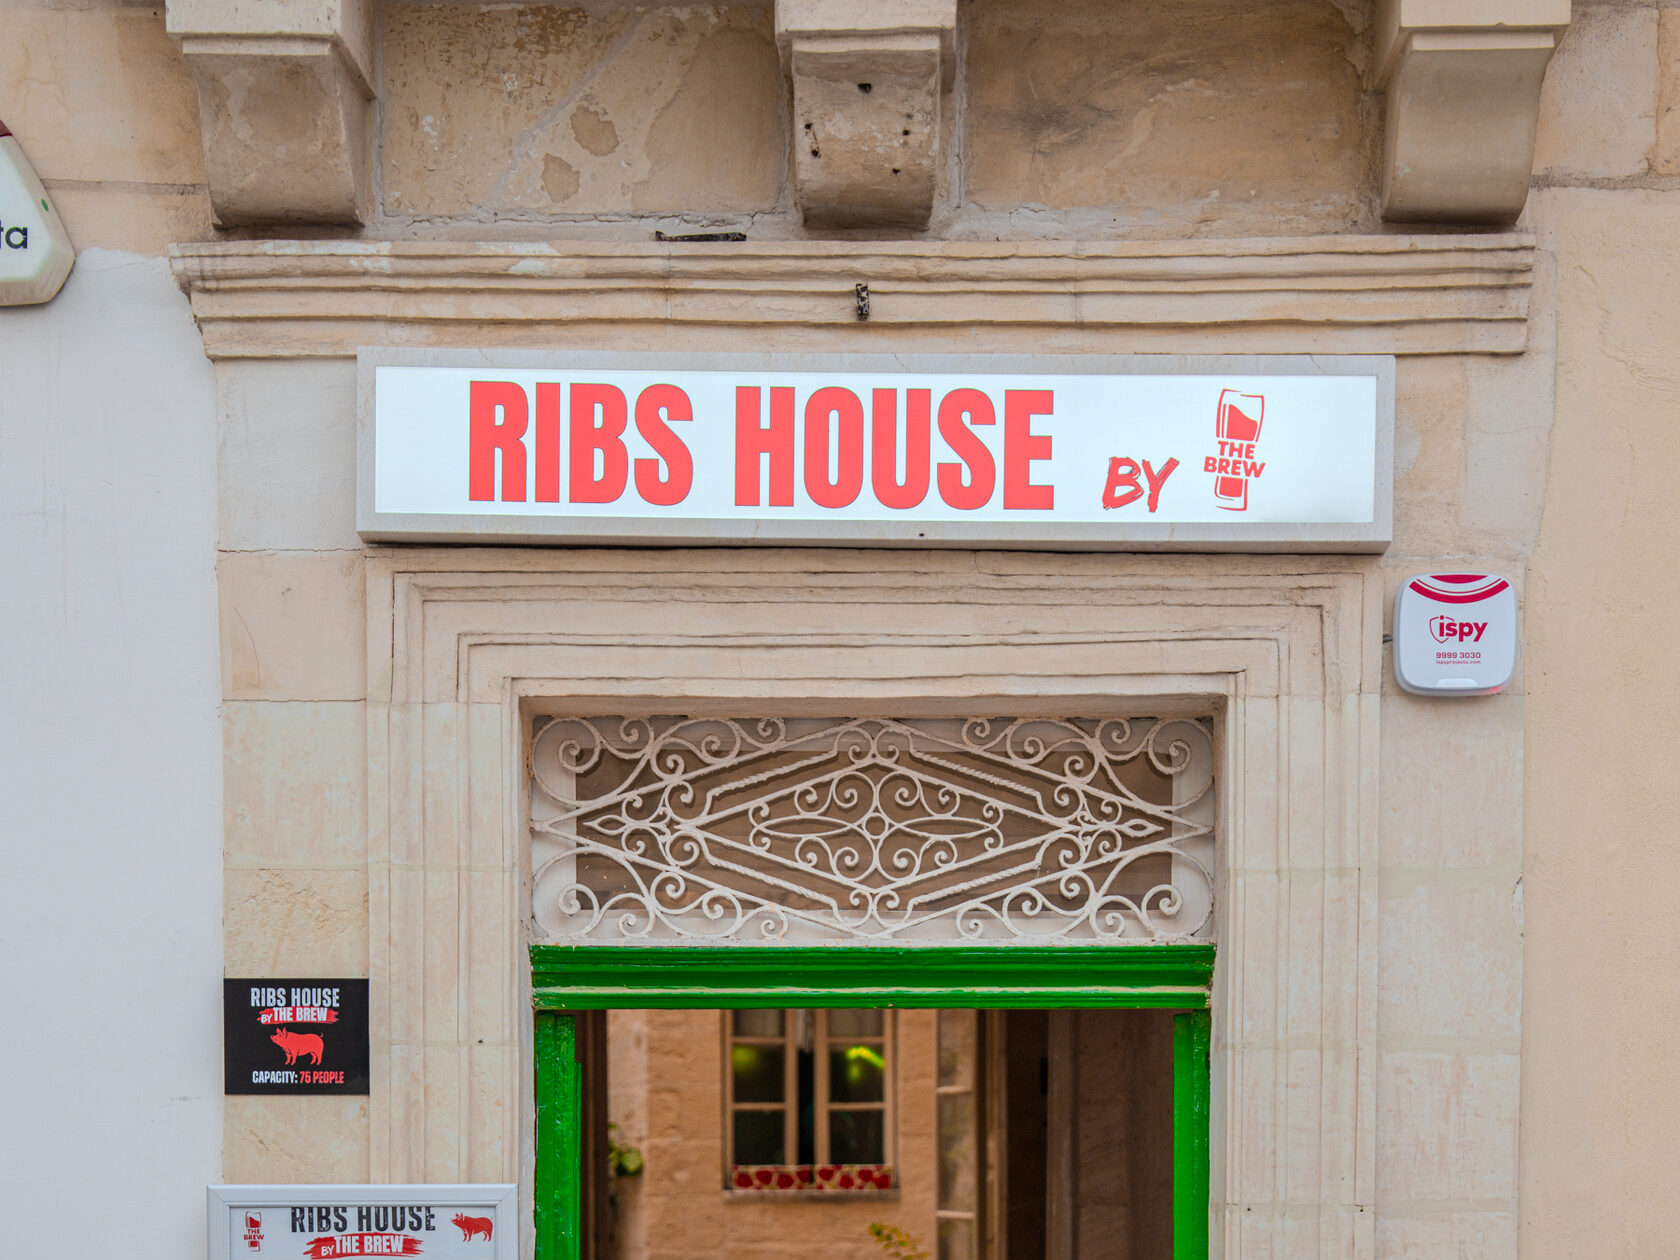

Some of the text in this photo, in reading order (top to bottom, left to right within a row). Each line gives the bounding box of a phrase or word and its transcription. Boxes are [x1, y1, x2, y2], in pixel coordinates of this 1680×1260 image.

[468, 380, 1180, 513] RIBS HOUSE BY
[1217, 440, 1255, 460] THE
[1203, 456, 1266, 478] BREW
[1439, 614, 1488, 642] ispy
[250, 987, 340, 1007] RIBS HOUSE
[260, 1007, 328, 1024] BY THE BREW
[252, 1071, 344, 1084] CAPACITY: 75 PEOPLE
[290, 1207, 436, 1233] RIBS HOUSE
[321, 1235, 404, 1256] BY THE BREW
